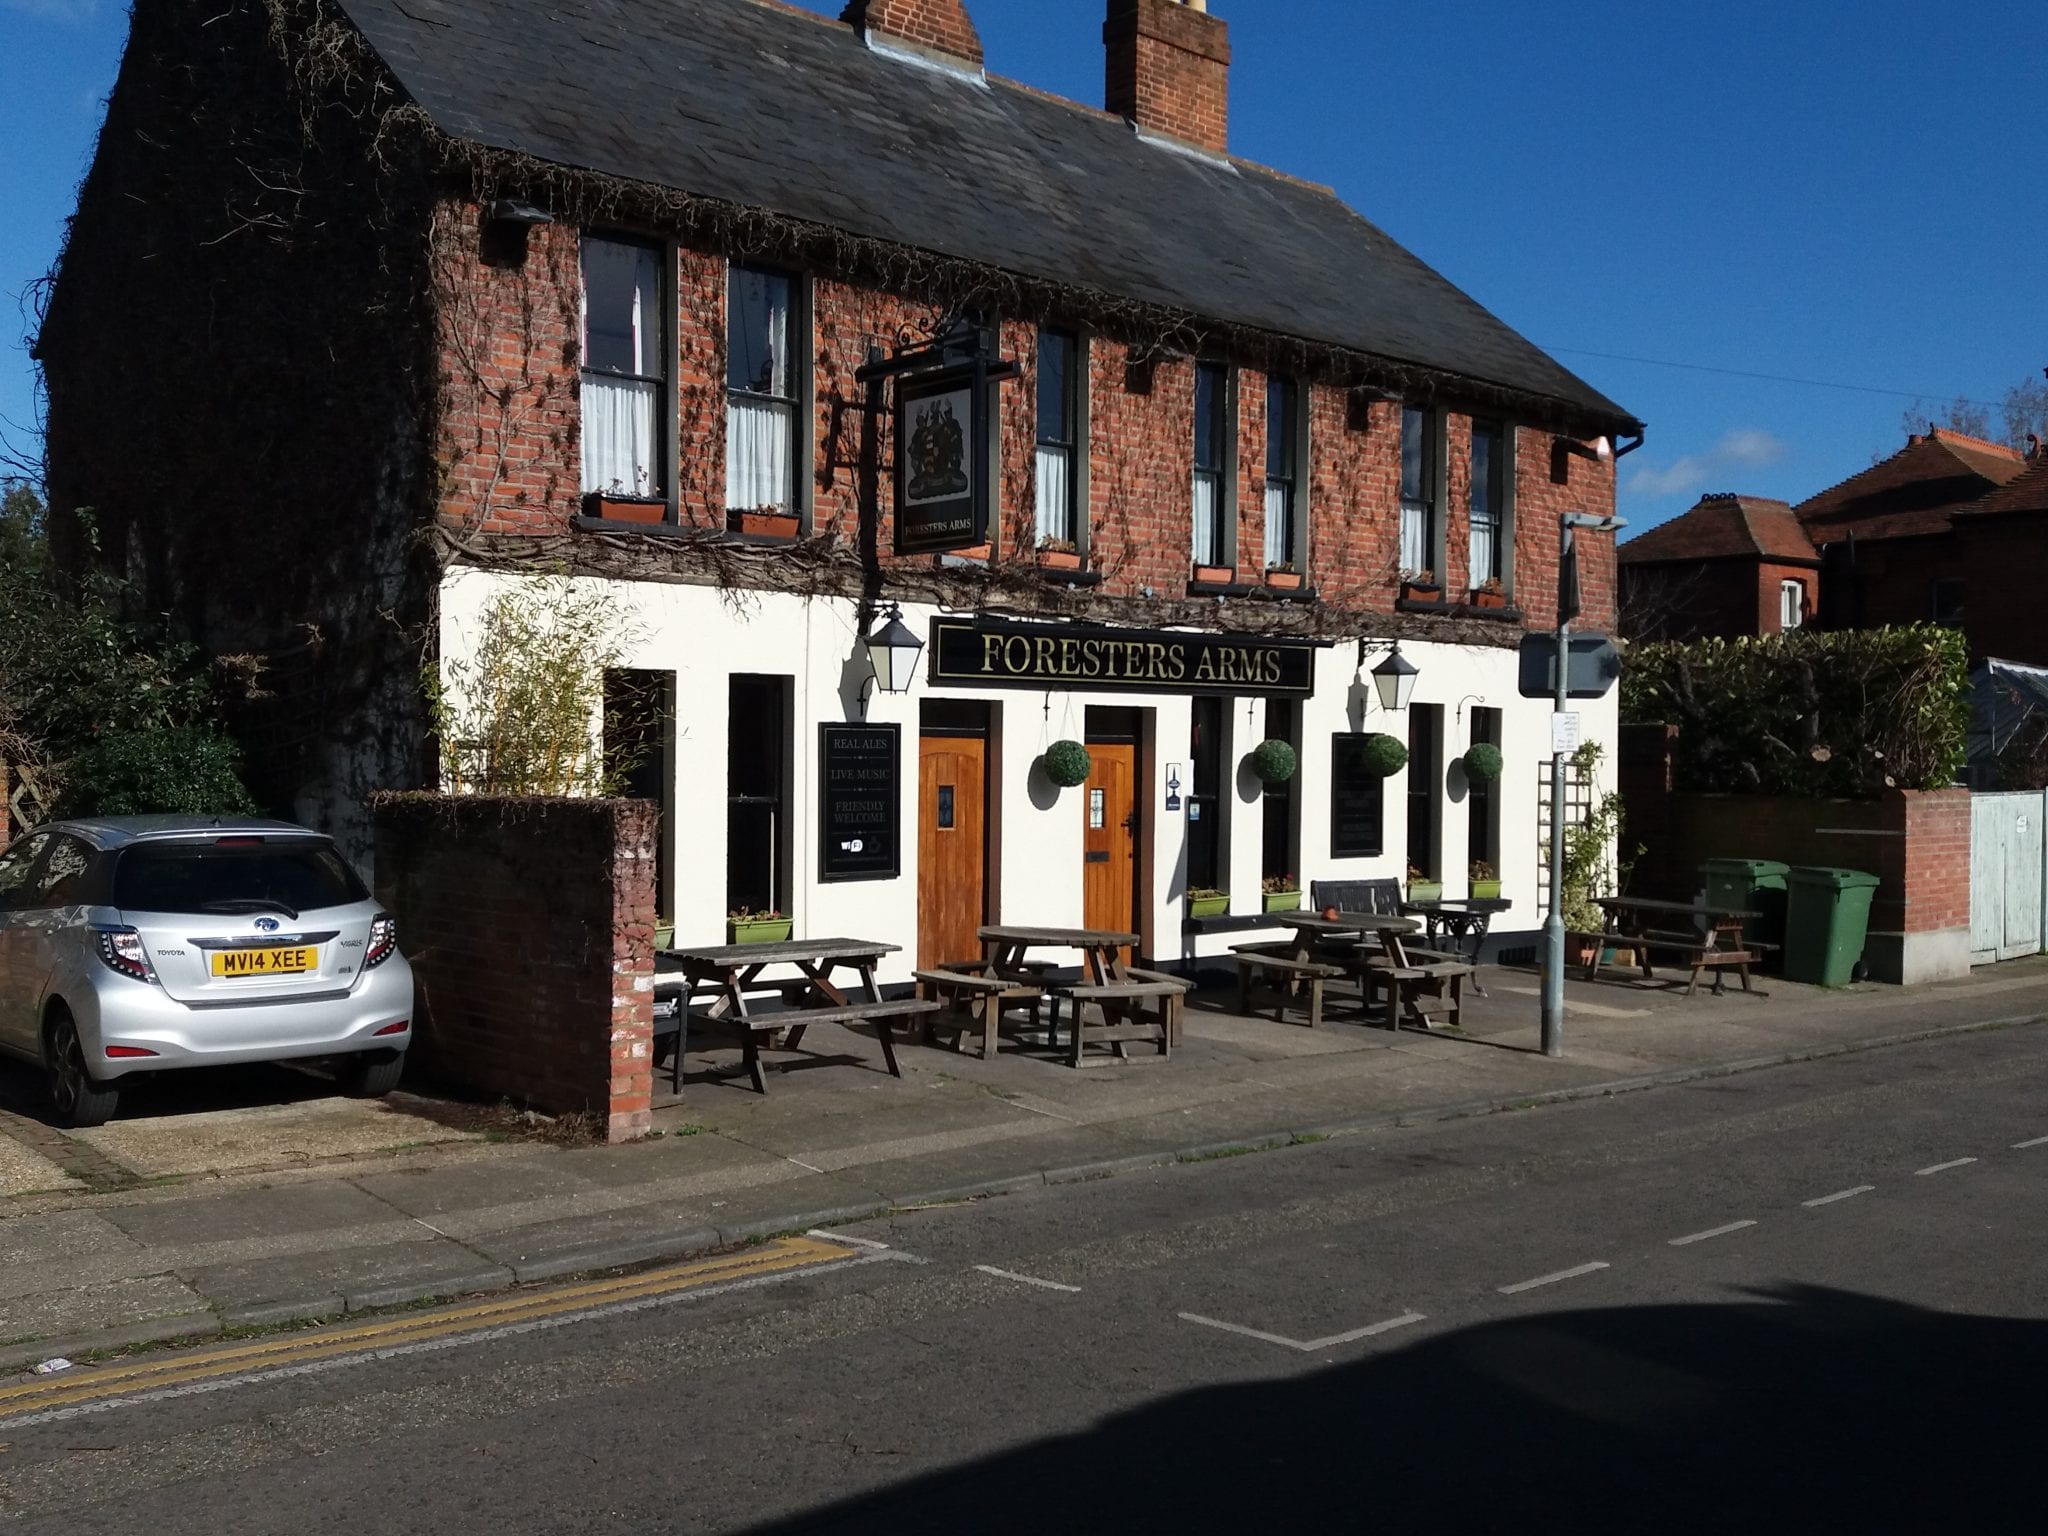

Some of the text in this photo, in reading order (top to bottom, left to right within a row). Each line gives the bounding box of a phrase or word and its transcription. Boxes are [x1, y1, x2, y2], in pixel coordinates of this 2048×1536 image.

[905, 518, 972, 536] FORESTERS ARMS
[981, 634, 1281, 683] FORESTERS ARMS
[834, 738, 887, 749] REAL ALES
[831, 769, 889, 780] LIVE MUSIC
[835, 800, 885, 812] FRIENDLY
[834, 813, 886, 824] WELCOME
[224, 950, 306, 972] MV14 XEE
